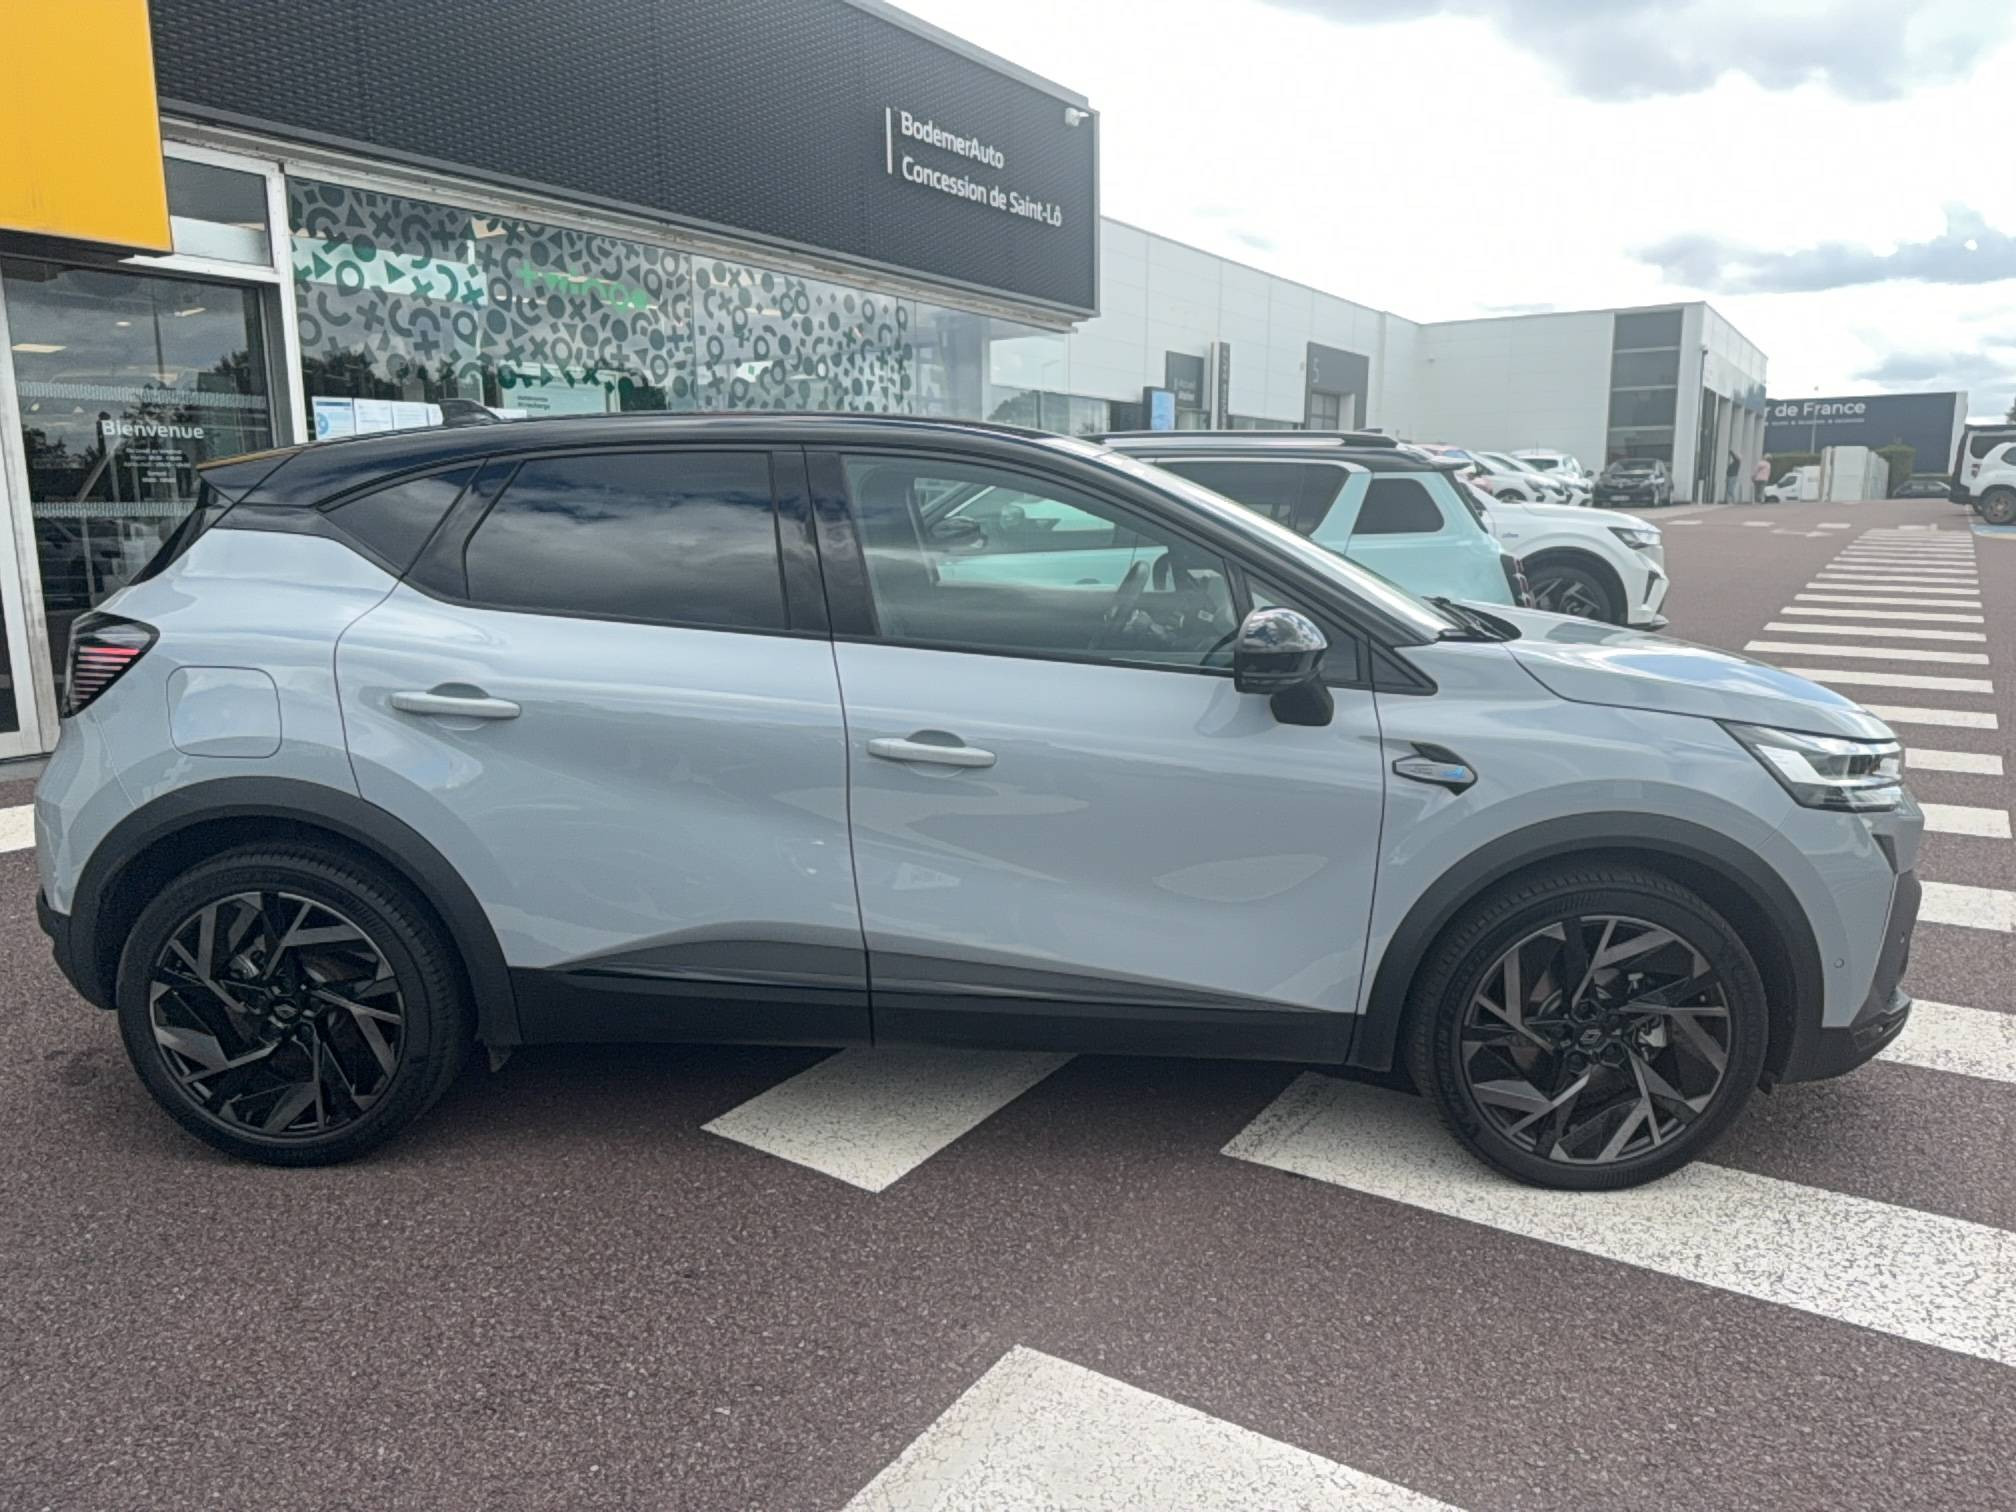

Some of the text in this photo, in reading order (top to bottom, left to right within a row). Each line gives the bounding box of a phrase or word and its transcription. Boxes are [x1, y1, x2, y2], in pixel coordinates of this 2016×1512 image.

[901, 111, 1004, 169] BodemerAuto
[902, 157, 1062, 227] Concession de Saint-Lô
[100, 419, 205, 439] Bienvenue
[1775, 403, 1799, 417] de
[1803, 402, 1866, 416] France
